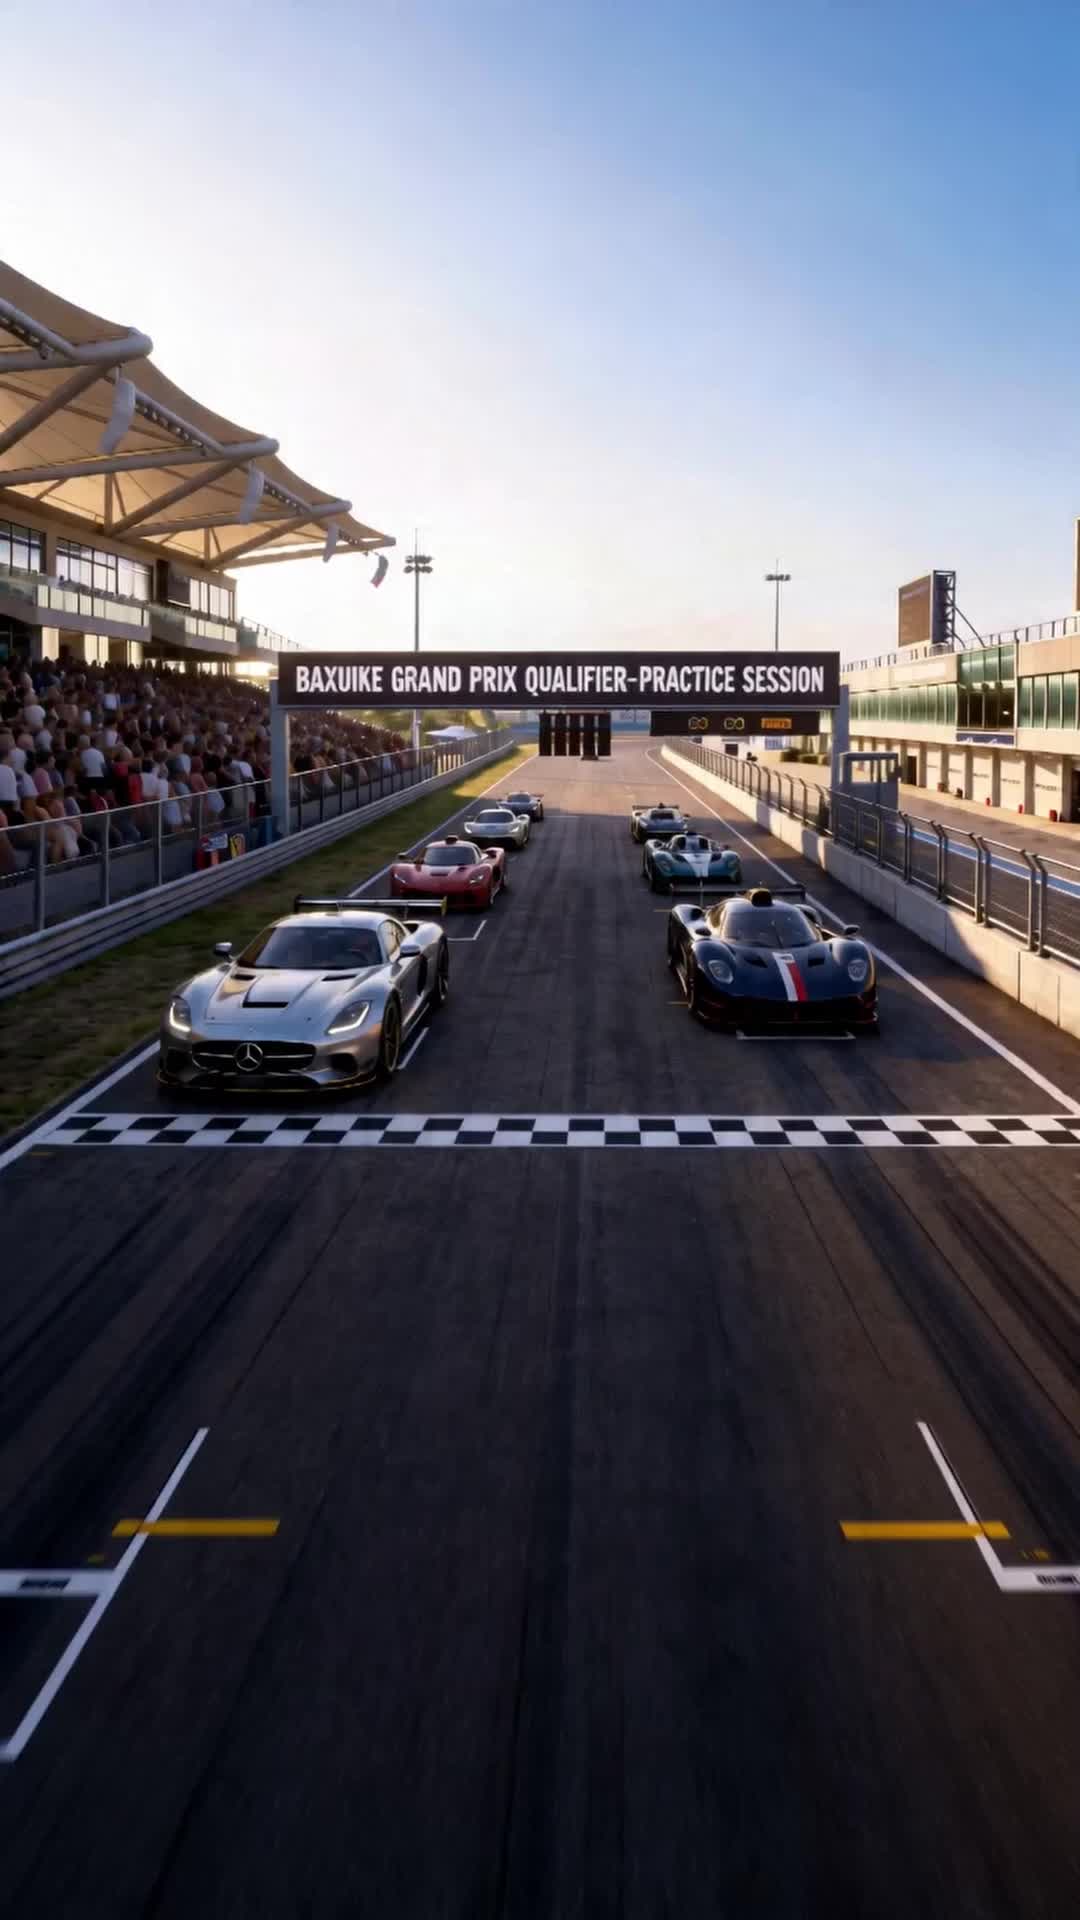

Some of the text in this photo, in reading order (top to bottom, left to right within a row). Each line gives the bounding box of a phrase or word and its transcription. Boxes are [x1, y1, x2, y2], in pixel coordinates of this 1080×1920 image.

[296, 665, 824, 697] BAXUIKE GRAND PRIX QUALIFIER-PRACTICE SESSION
